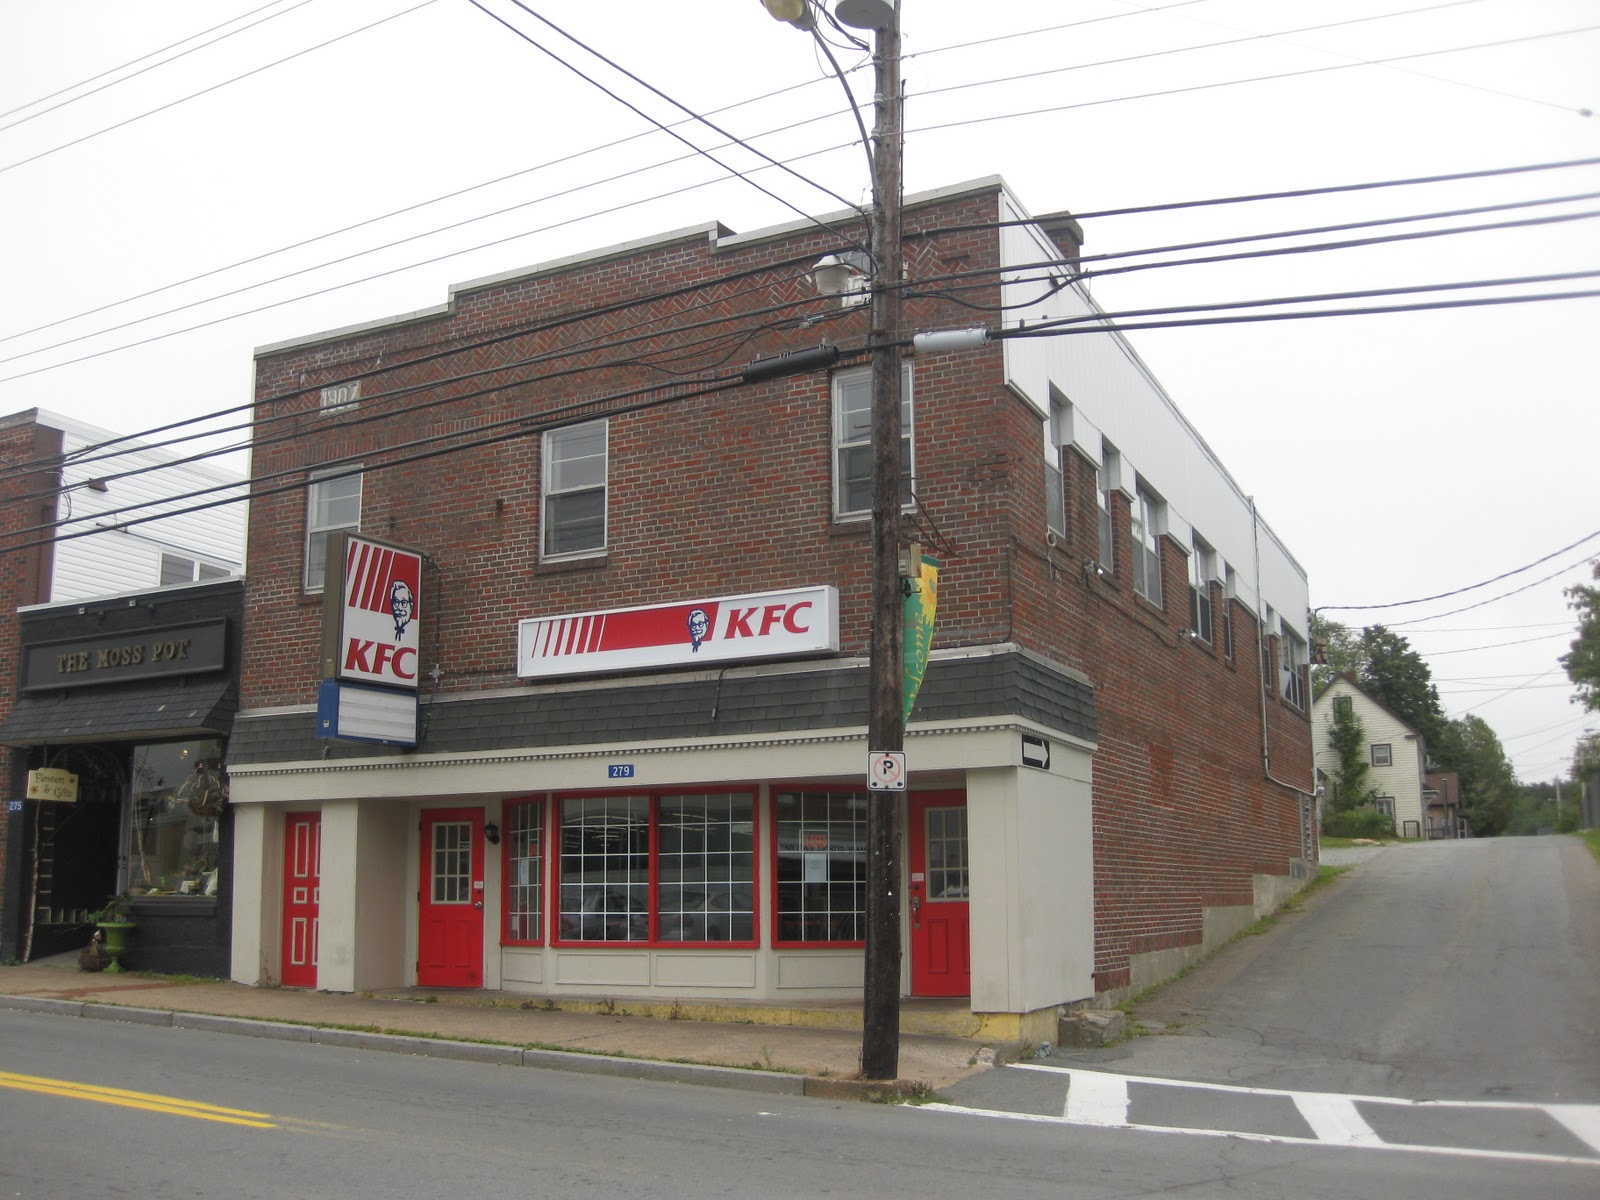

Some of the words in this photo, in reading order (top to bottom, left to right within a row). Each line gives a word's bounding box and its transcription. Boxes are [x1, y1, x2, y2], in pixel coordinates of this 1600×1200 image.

[723, 601, 813, 640] KFC
[56, 650, 89, 673] THE
[97, 644, 144, 669] MOSS
[151, 639, 190, 662] POT
[344, 637, 417, 680] KFC
[612, 765, 630, 777] 279
[883, 760, 894, 775] P
[35, 772, 65, 785] Flowers
[44, 784, 52, 794] &
[54, 786, 73, 799] Gifts
[9, 801, 22, 811] 275
